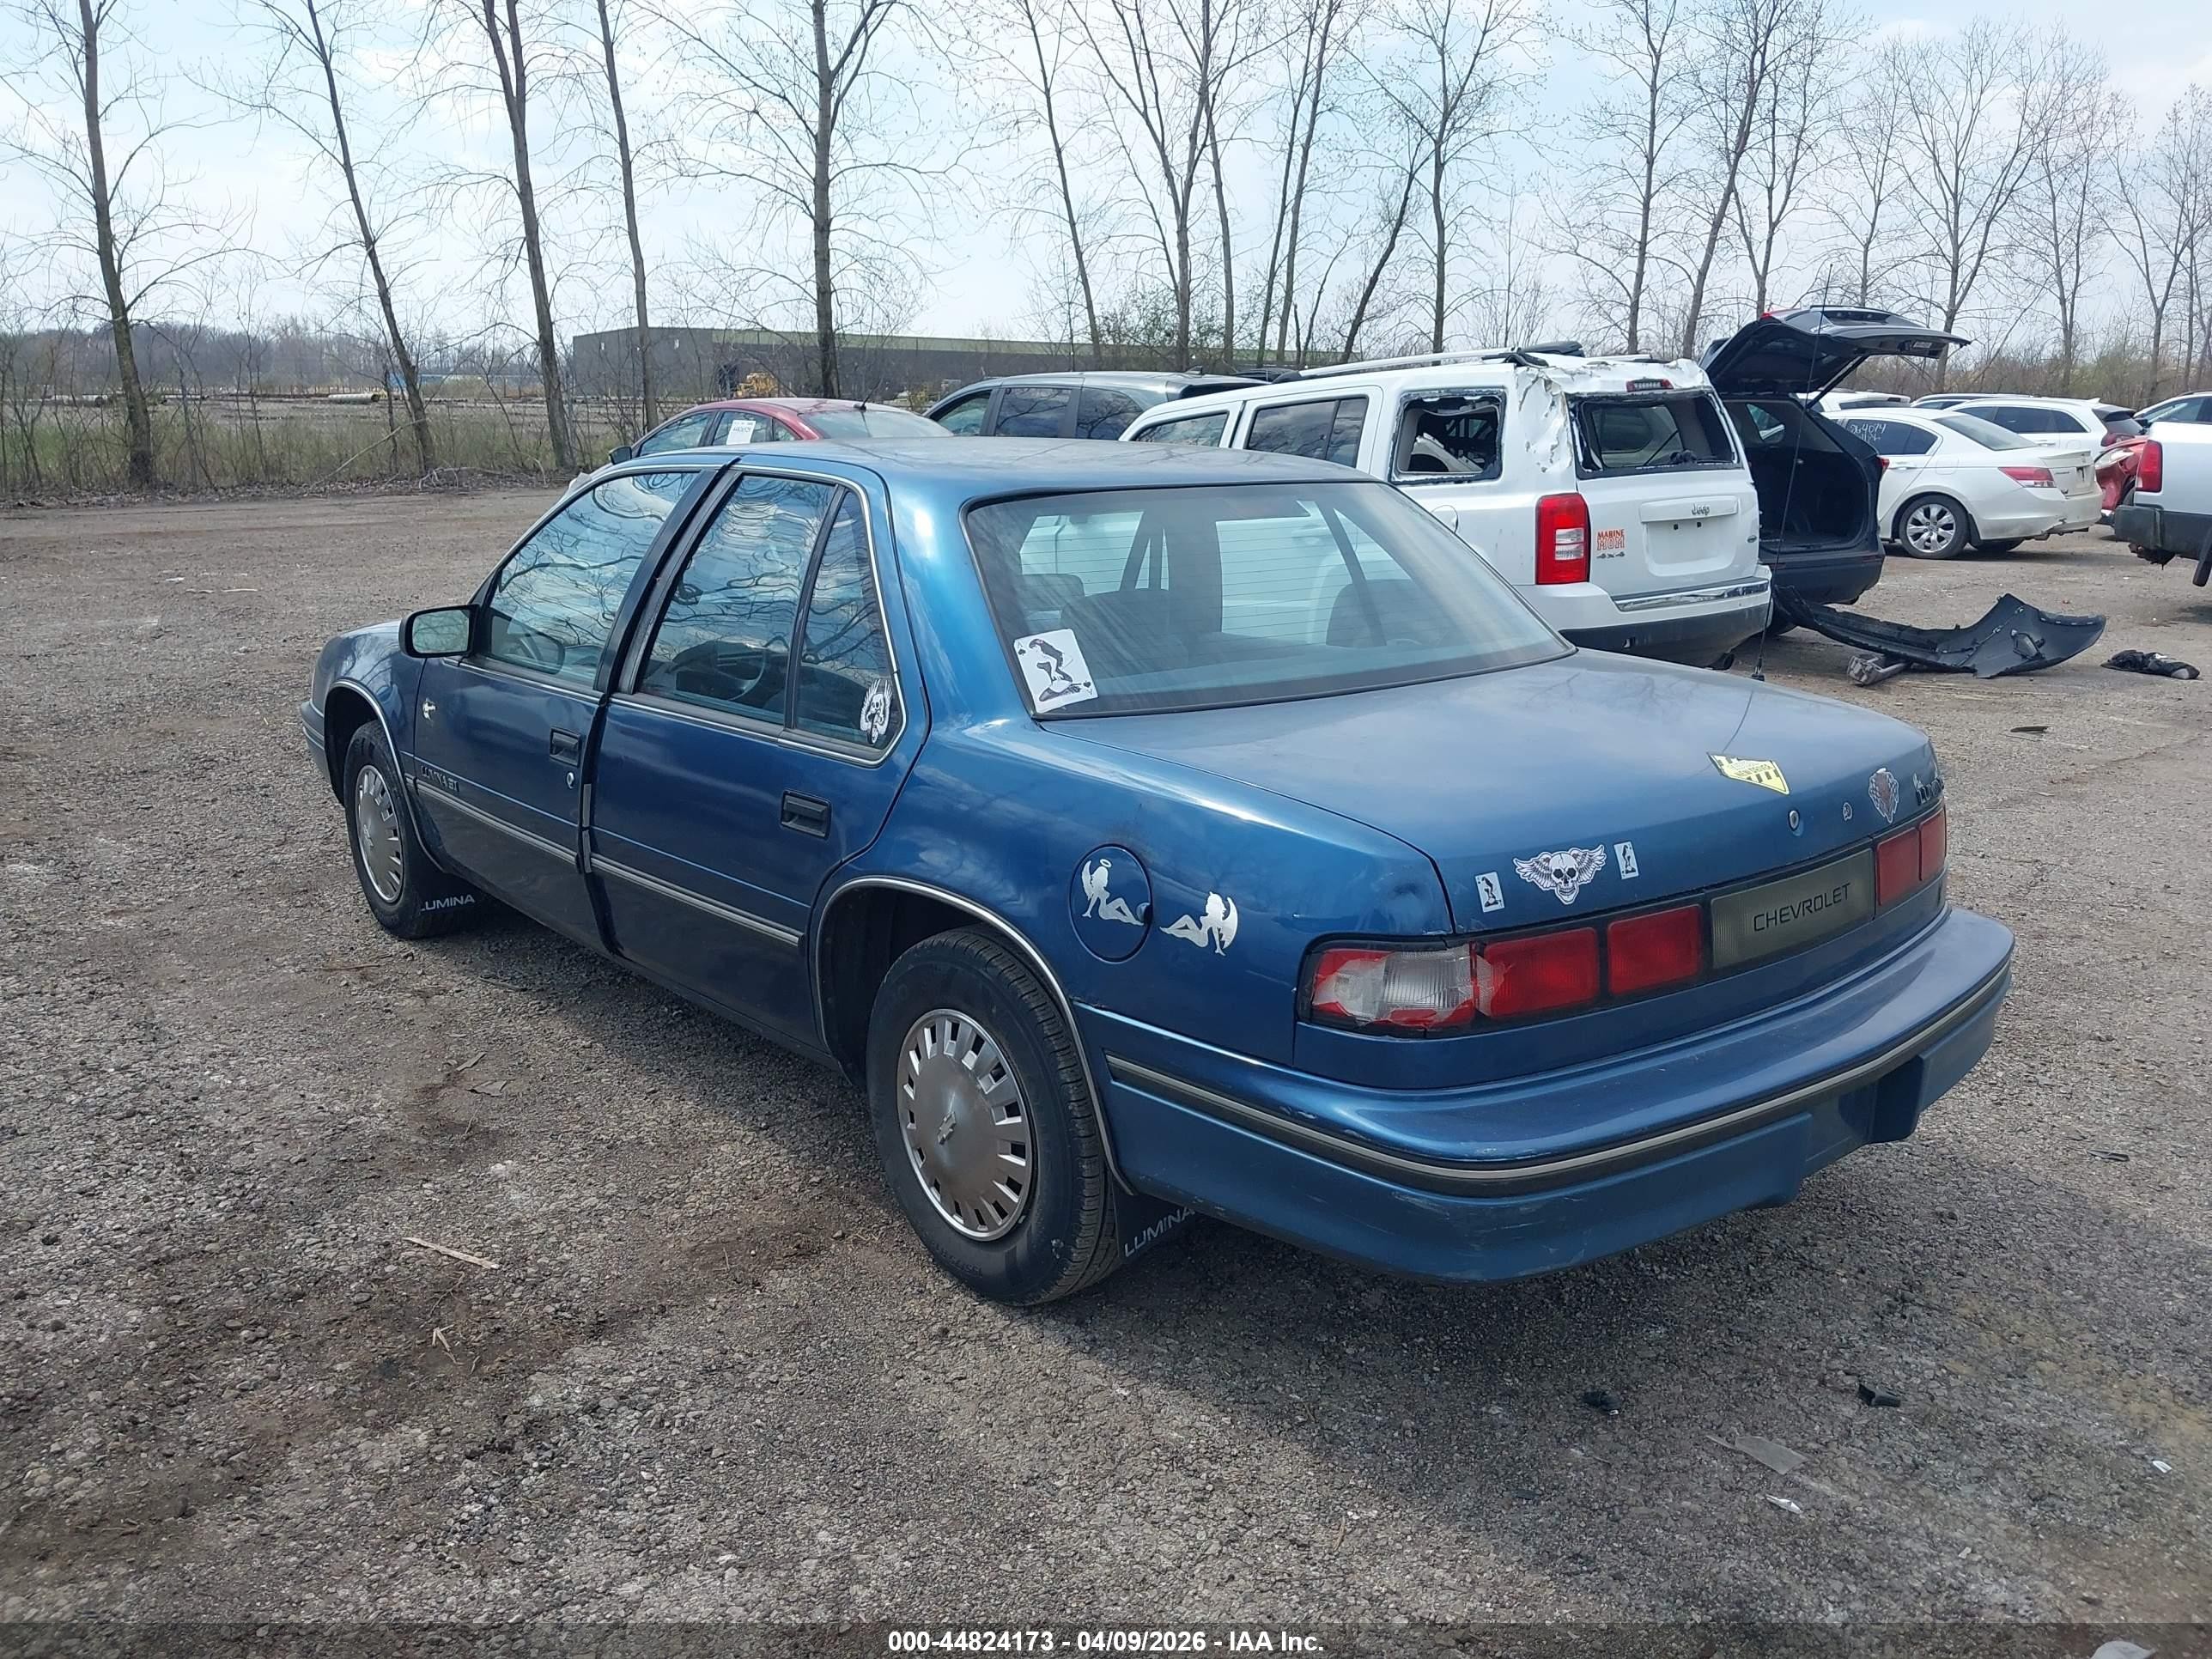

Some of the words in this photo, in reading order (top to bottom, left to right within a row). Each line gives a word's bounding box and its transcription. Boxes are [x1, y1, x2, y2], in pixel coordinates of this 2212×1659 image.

[1692, 503, 1710, 516] Jeep
[1597, 529, 1625, 538] MARINE
[1597, 536, 1626, 551] MOM
[1753, 883, 1850, 932] CHEVROLET
